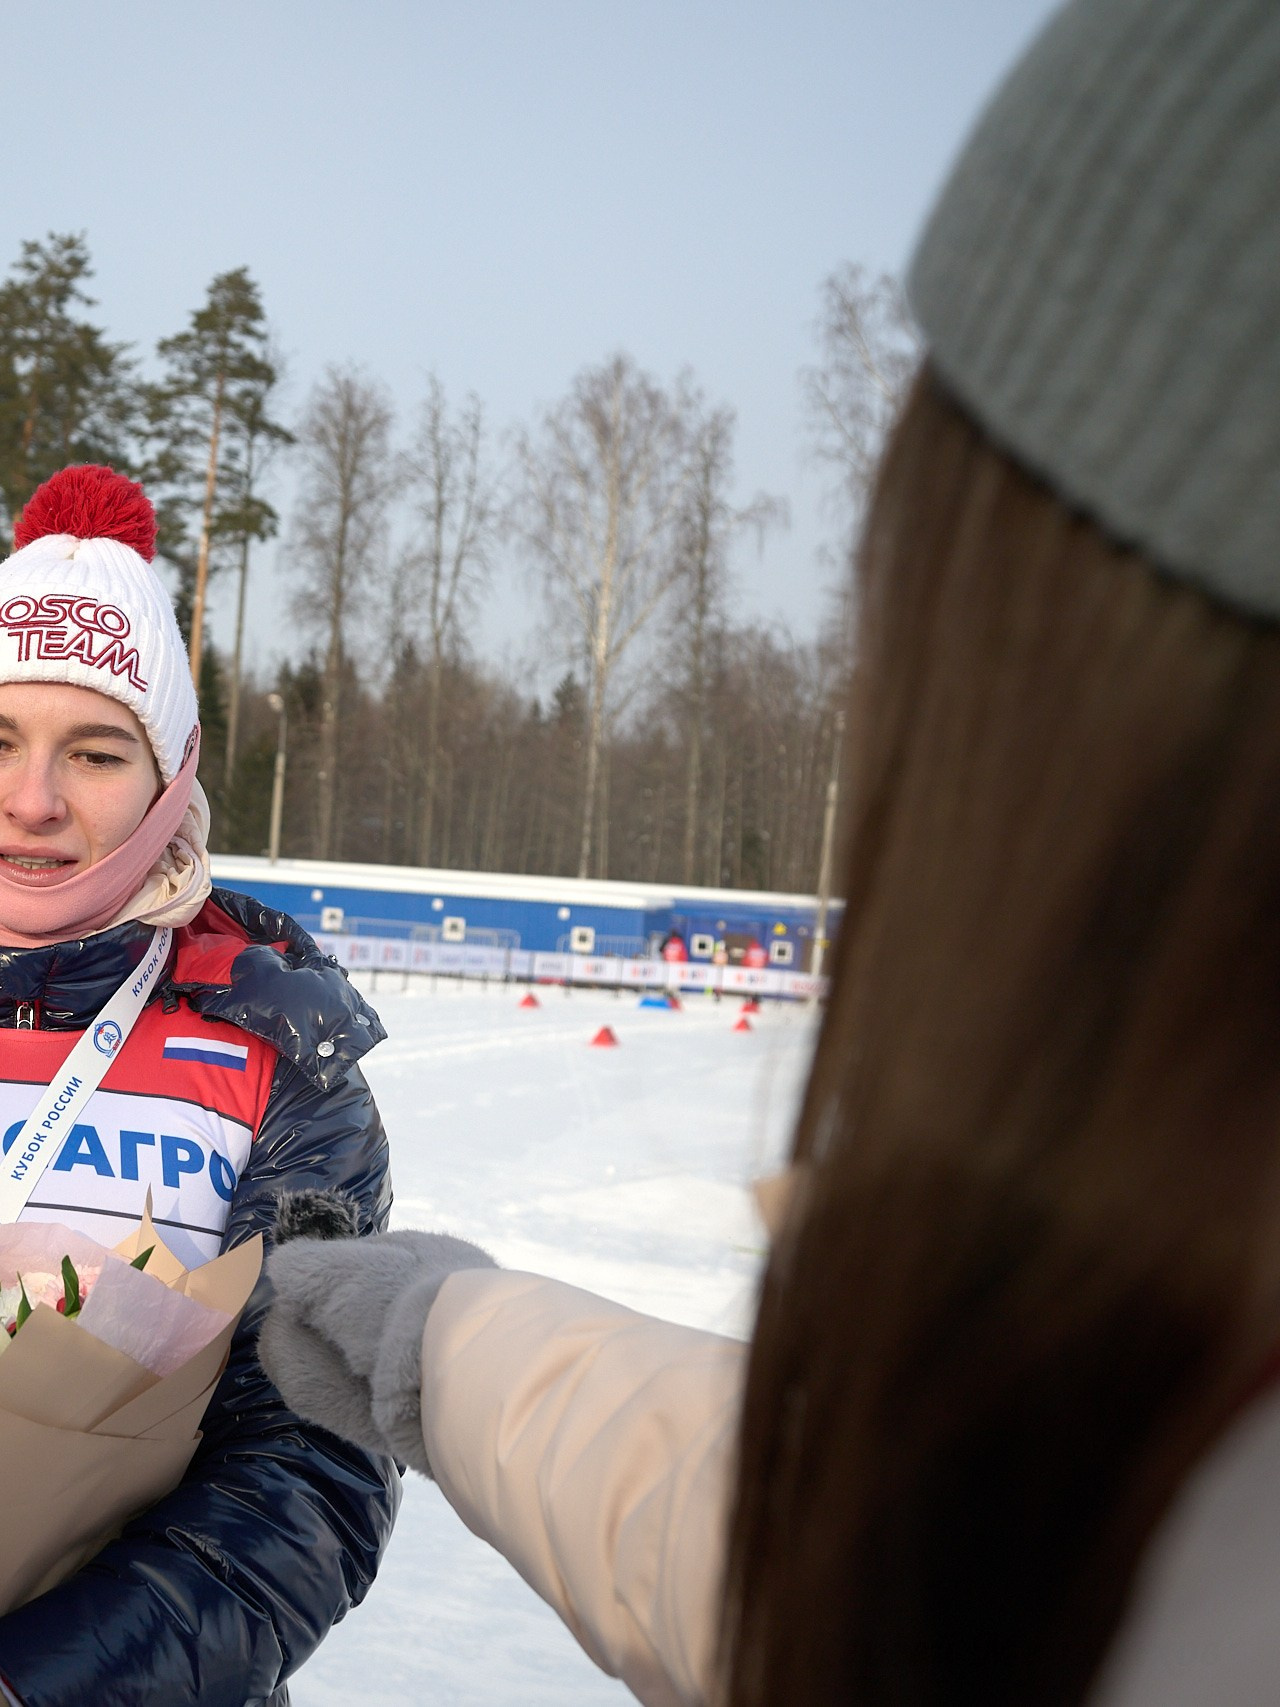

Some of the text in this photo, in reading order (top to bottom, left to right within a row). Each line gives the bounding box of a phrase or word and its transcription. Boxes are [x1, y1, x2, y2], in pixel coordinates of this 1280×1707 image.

[7, 625, 148, 693] TEAM
[131, 926, 169, 998] КУБОК РОС
[10, 1075, 83, 1181] КУБОК РОССИИ
